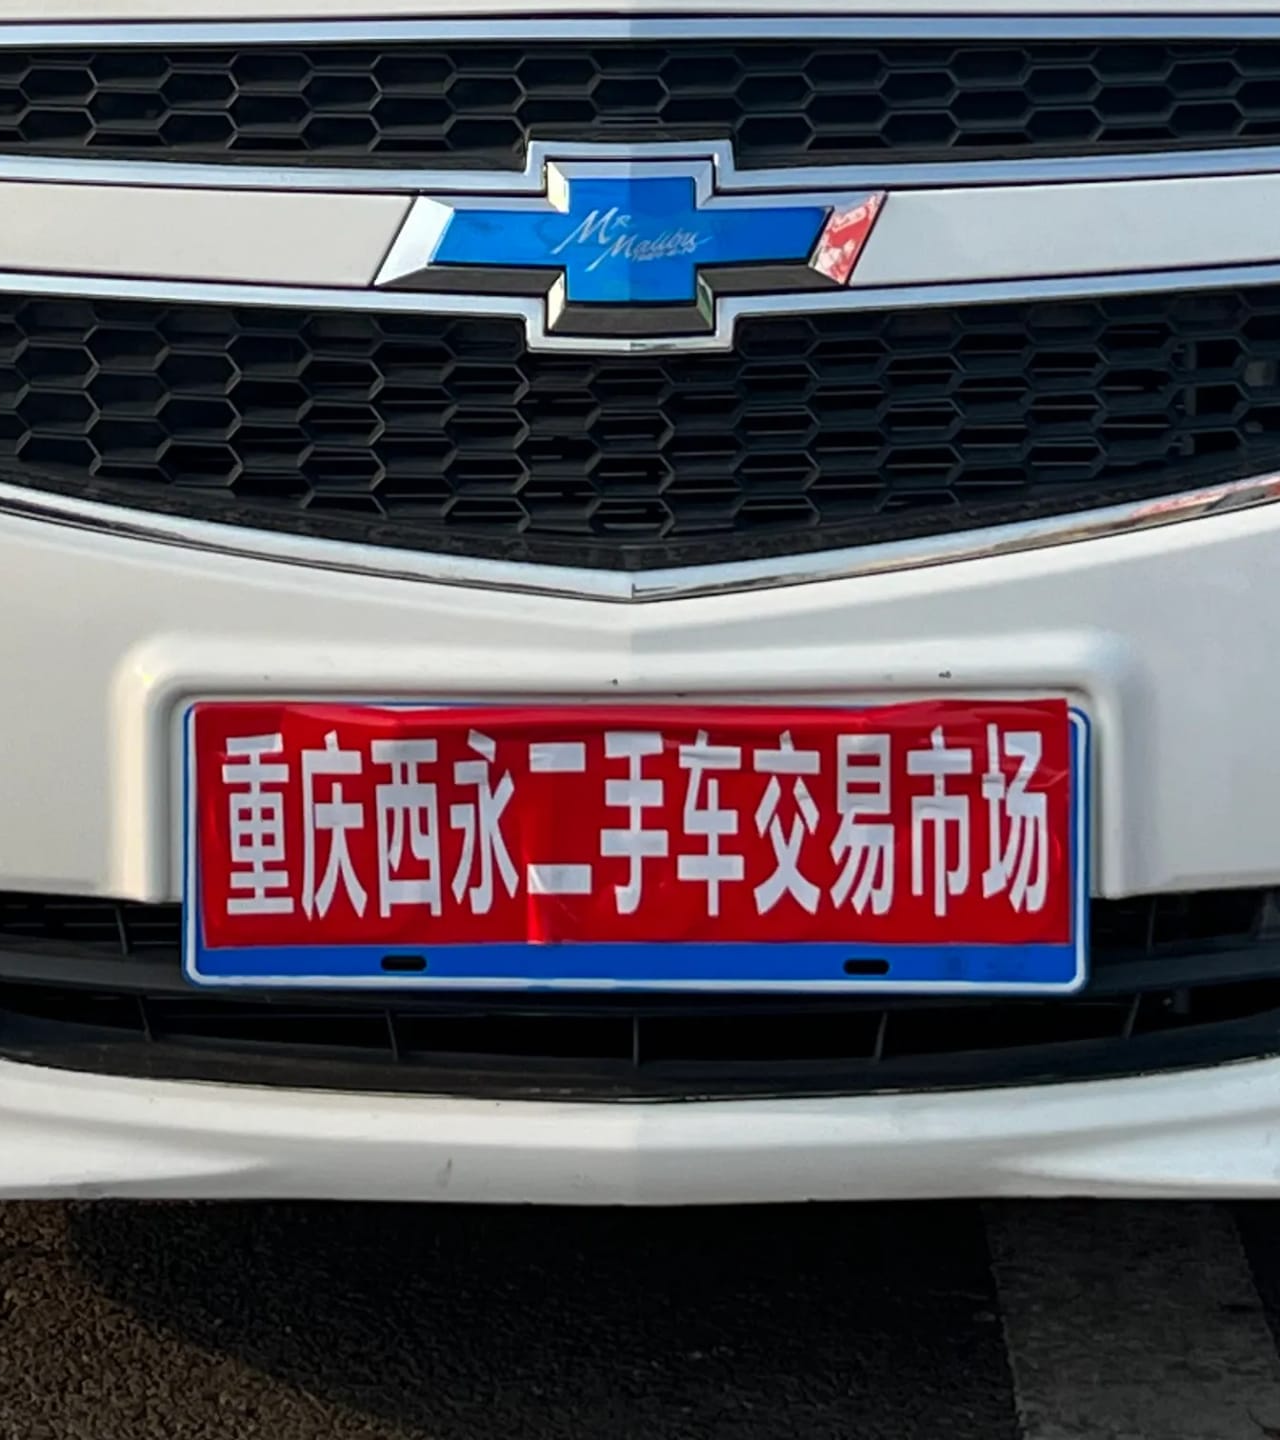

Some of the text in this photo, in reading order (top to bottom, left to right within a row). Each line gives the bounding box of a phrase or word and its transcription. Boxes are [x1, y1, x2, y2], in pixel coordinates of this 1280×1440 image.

[221, 723, 1050, 921] 重庆西永二手车交易市场
